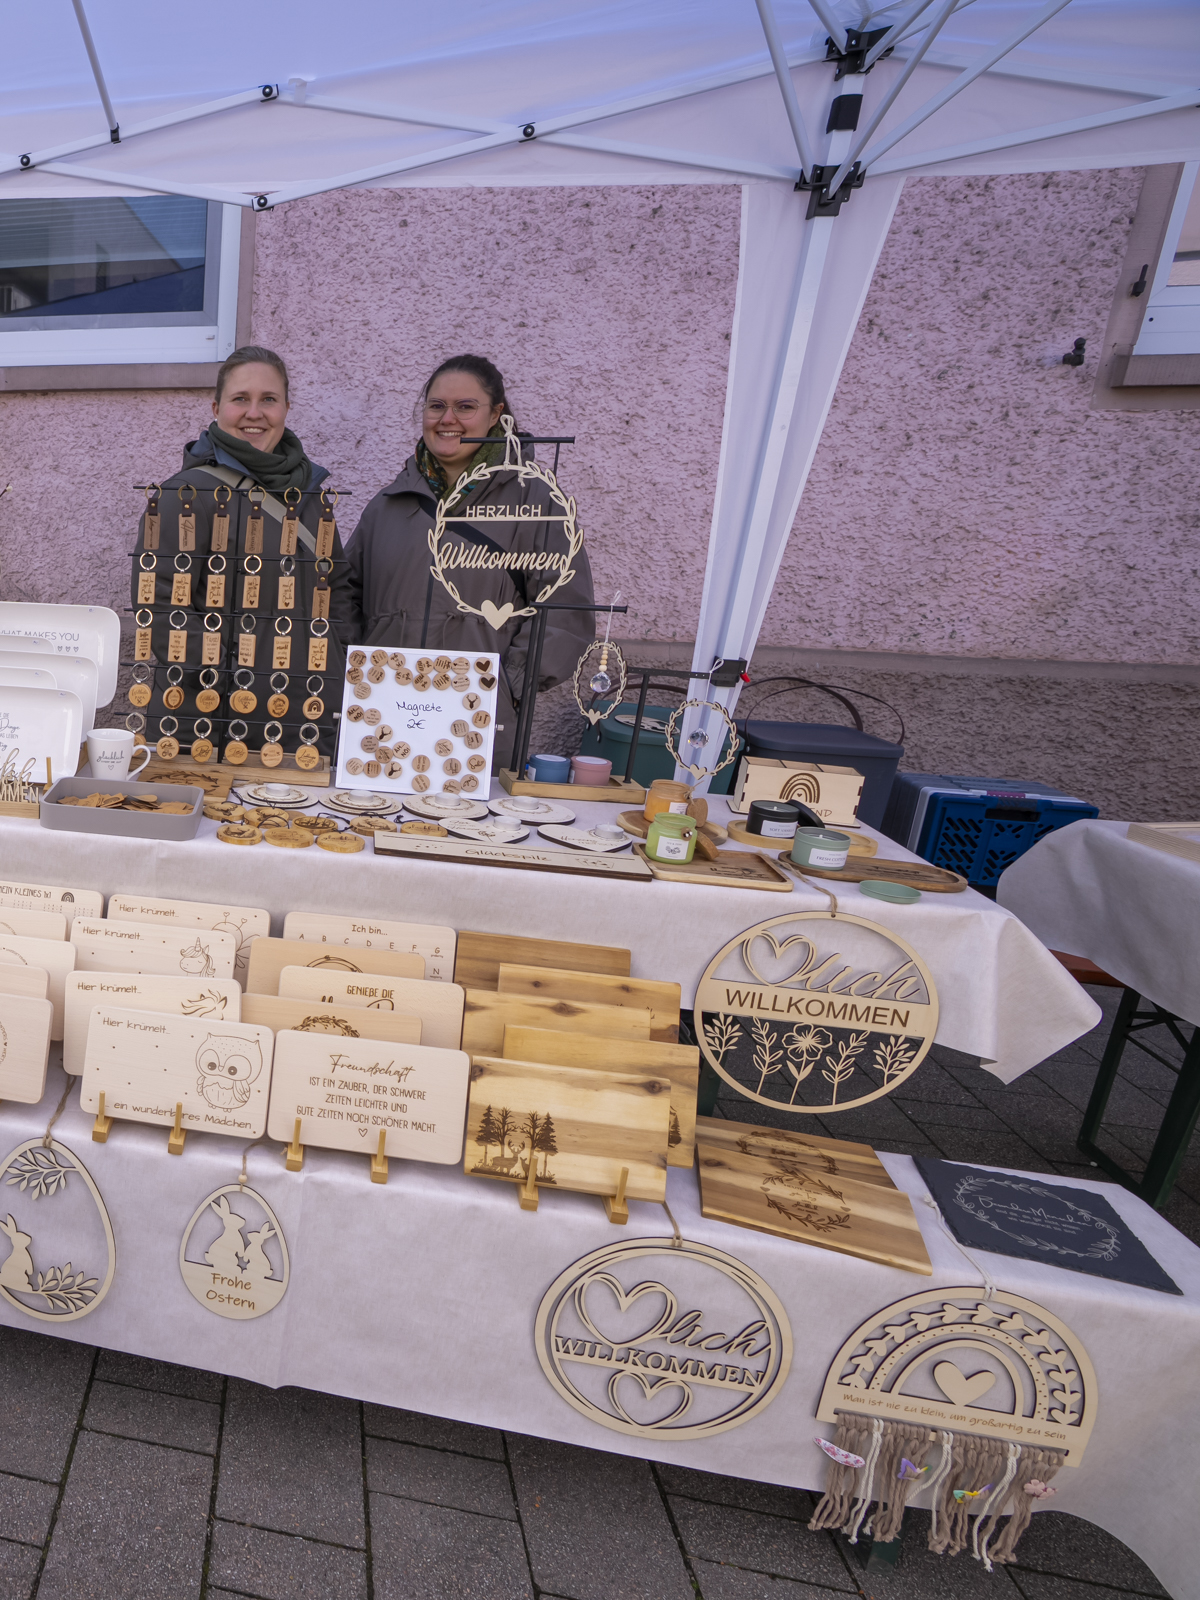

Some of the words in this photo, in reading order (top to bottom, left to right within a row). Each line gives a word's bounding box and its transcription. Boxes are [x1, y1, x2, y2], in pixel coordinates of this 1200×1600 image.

[466, 504, 542, 518] HERZLICH
[440, 542, 562, 571] Willkommen
[59, 631, 80, 642] YOU
[395, 701, 443, 717] Magnete
[406, 718, 427, 730] 2€
[465, 849, 552, 863] Glückspilz
[15, 887, 42, 898] KLEINES
[119, 903, 137, 914] Hier
[82, 926, 101, 936] Hier
[351, 924, 366, 934] Ich
[368, 924, 388, 937] bin...
[321, 935, 327, 943] B
[343, 937, 350, 945] C
[366, 940, 372, 948] D
[389, 941, 395, 950] E
[411, 944, 418, 952] F
[434, 946, 441, 954] G
[432, 967, 440, 976] N
[77, 982, 97, 991] Hier
[381, 988, 395, 1000] DIE
[725, 988, 911, 1029] WILLKOMMEN
[102, 1017, 123, 1028] Hier
[329, 1053, 417, 1084] Freundschaft
[309, 1076, 321, 1087] IST
[322, 1077, 336, 1089] EIN
[337, 1079, 370, 1095] ZAUBER,
[372, 1084, 388, 1096] DER
[390, 1085, 428, 1101] SCHWERE
[325, 1093, 352, 1107] ZEITEN
[354, 1096, 389, 1112] LEICHTER
[390, 1101, 408, 1114] UND
[113, 1101, 128, 1112] ein
[132, 1103, 201, 1122] wunderbres
[204, 1113, 252, 1130] Mädchen
[296, 1104, 315, 1118] GUTE
[317, 1107, 344, 1121] ZEITEN
[346, 1111, 370, 1125] NOCH
[371, 1115, 409, 1130] SCHÖNER
[411, 1121, 437, 1134] MACHT.
[210, 1271, 252, 1291] Frohe
[206, 1289, 256, 1311] Ostern
[666, 1309, 772, 1359] lich
[555, 1335, 765, 1387] WILLKOMMEN
[843, 1393, 866, 1404] Man
[868, 1397, 884, 1407] ist
[886, 1401, 901, 1410] nie
[904, 1405, 918, 1414] zu
[920, 1406, 947, 1420] klein,
[949, 1413, 967, 1422] um
[969, 1417, 1024, 1435] großartig
[1027, 1427, 1042, 1436] zu
[1044, 1428, 1067, 1440] sein
